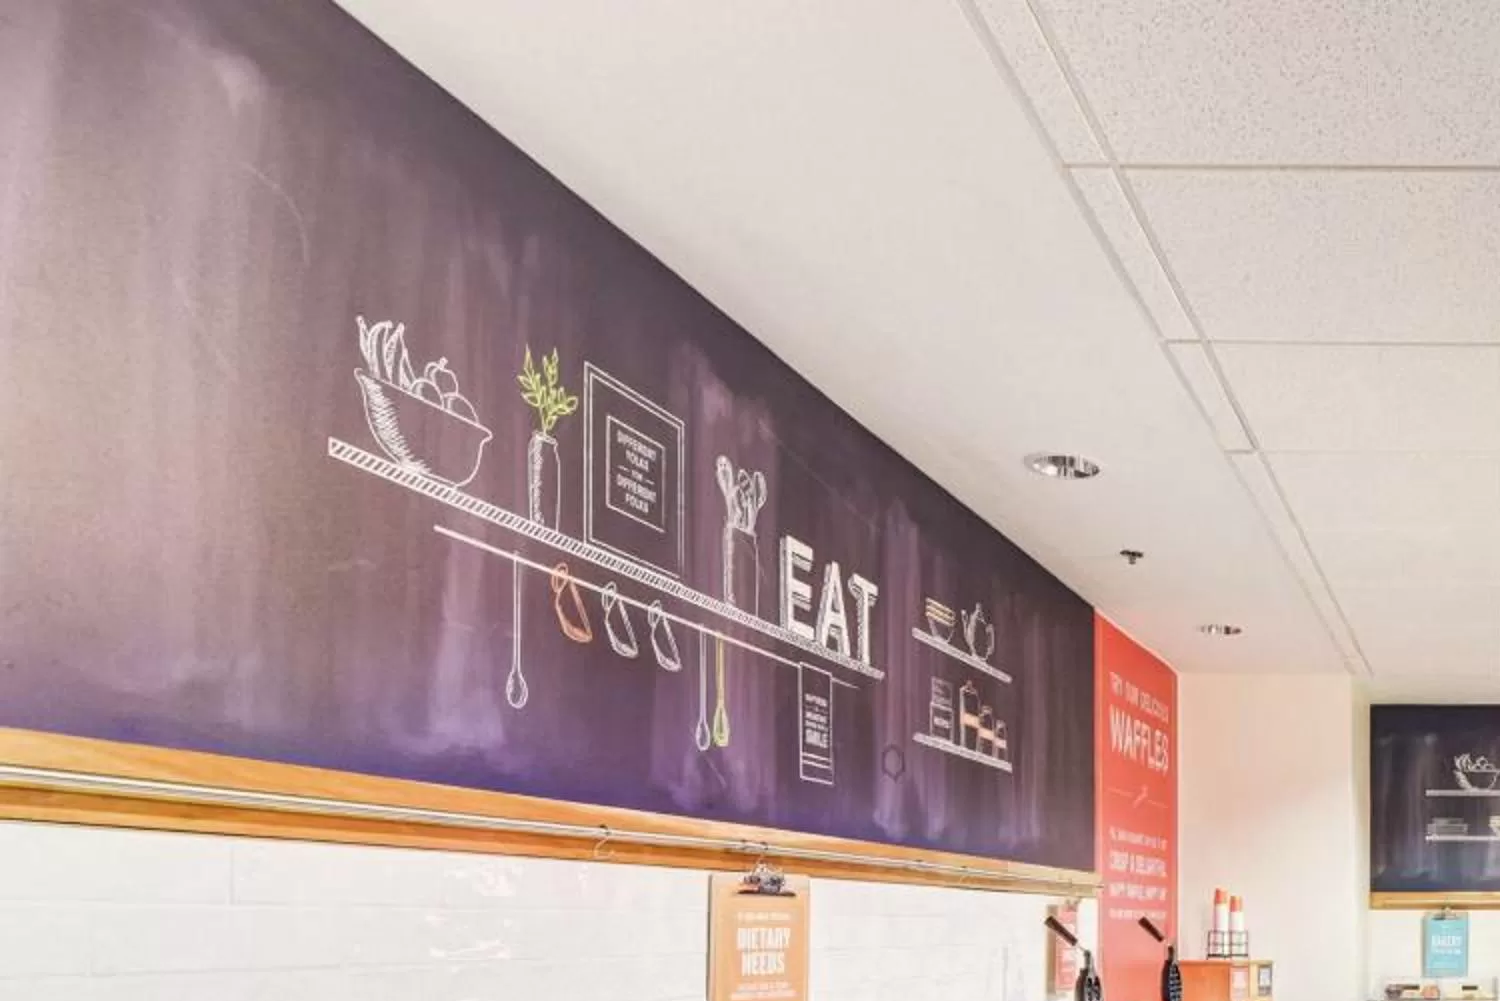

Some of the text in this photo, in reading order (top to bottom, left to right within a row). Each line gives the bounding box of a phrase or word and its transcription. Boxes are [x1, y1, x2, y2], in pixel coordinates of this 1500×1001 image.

[780, 535, 879, 665] EAT
[1109, 703, 1169, 777] WAFFLES
[736, 927, 791, 950] DIETARY
[741, 951, 785, 976] NEEDS
